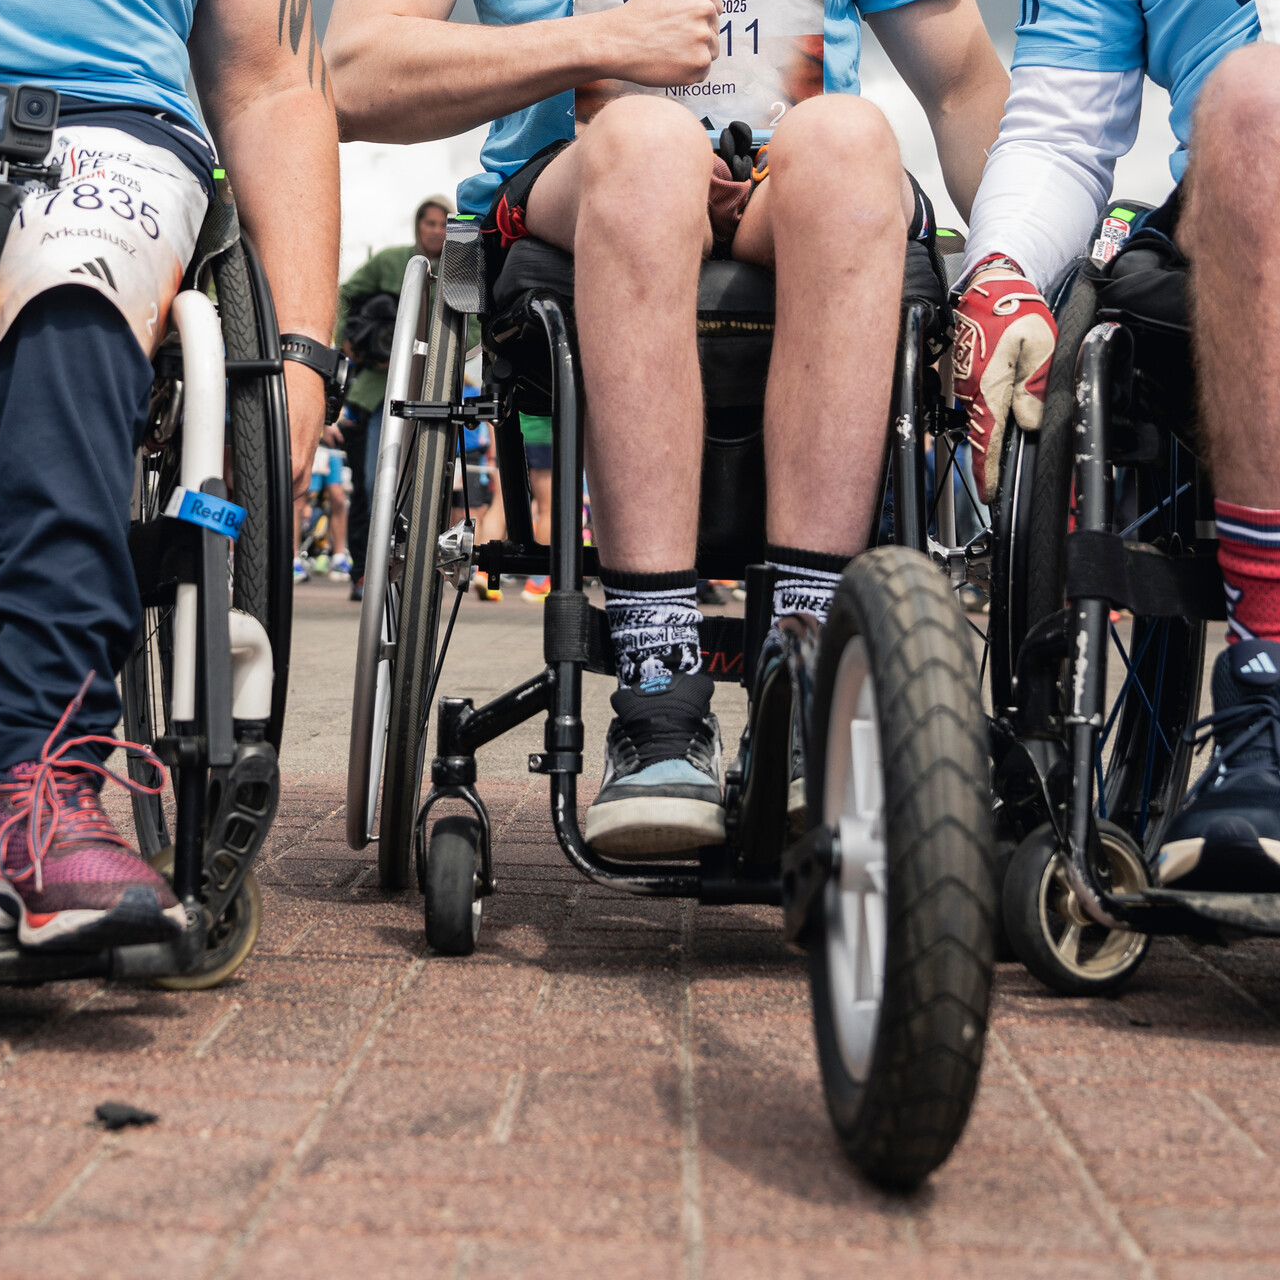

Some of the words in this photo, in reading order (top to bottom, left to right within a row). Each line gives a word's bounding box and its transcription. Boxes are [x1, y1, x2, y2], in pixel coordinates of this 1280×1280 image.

[665, 81, 736, 97] Nikodem
[110, 170, 142, 193] 2025
[40, 224, 138, 260] Arkadiusz
